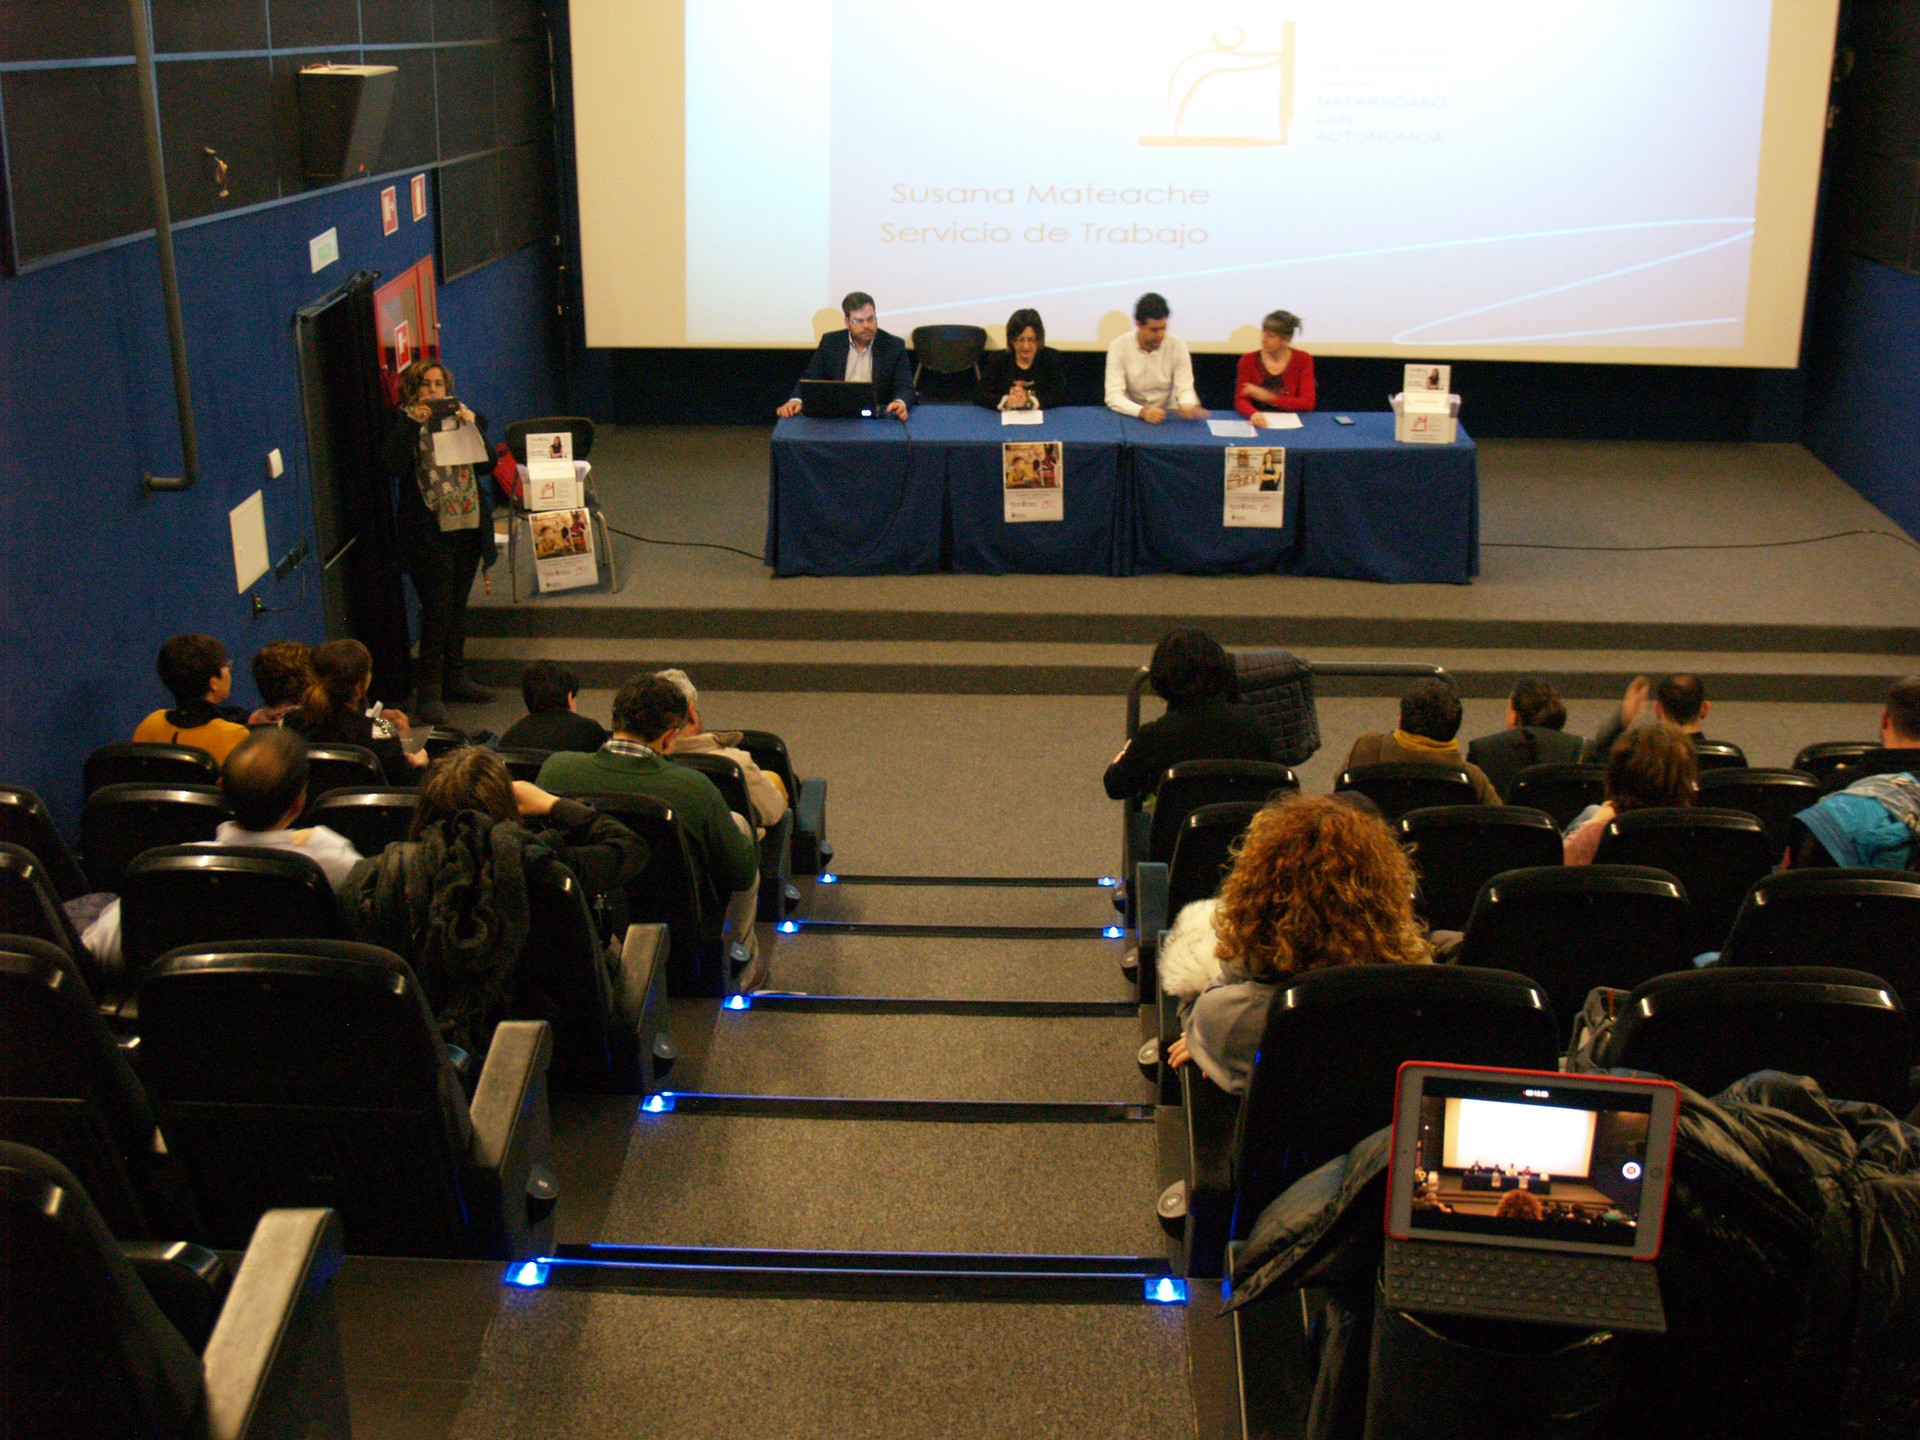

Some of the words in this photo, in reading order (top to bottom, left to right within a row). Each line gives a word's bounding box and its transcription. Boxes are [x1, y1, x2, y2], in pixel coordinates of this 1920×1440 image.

[1316, 95, 1448, 109] NAFARROAKO
[1315, 112, 1353, 126] LAN
[1315, 129, 1446, 144] AUTONOMOA
[891, 183, 1015, 205] Susana
[1027, 183, 1211, 206] Mateache
[879, 221, 1012, 245] Servicio
[1023, 222, 1070, 245] de
[1081, 222, 1209, 250] Trabajo
